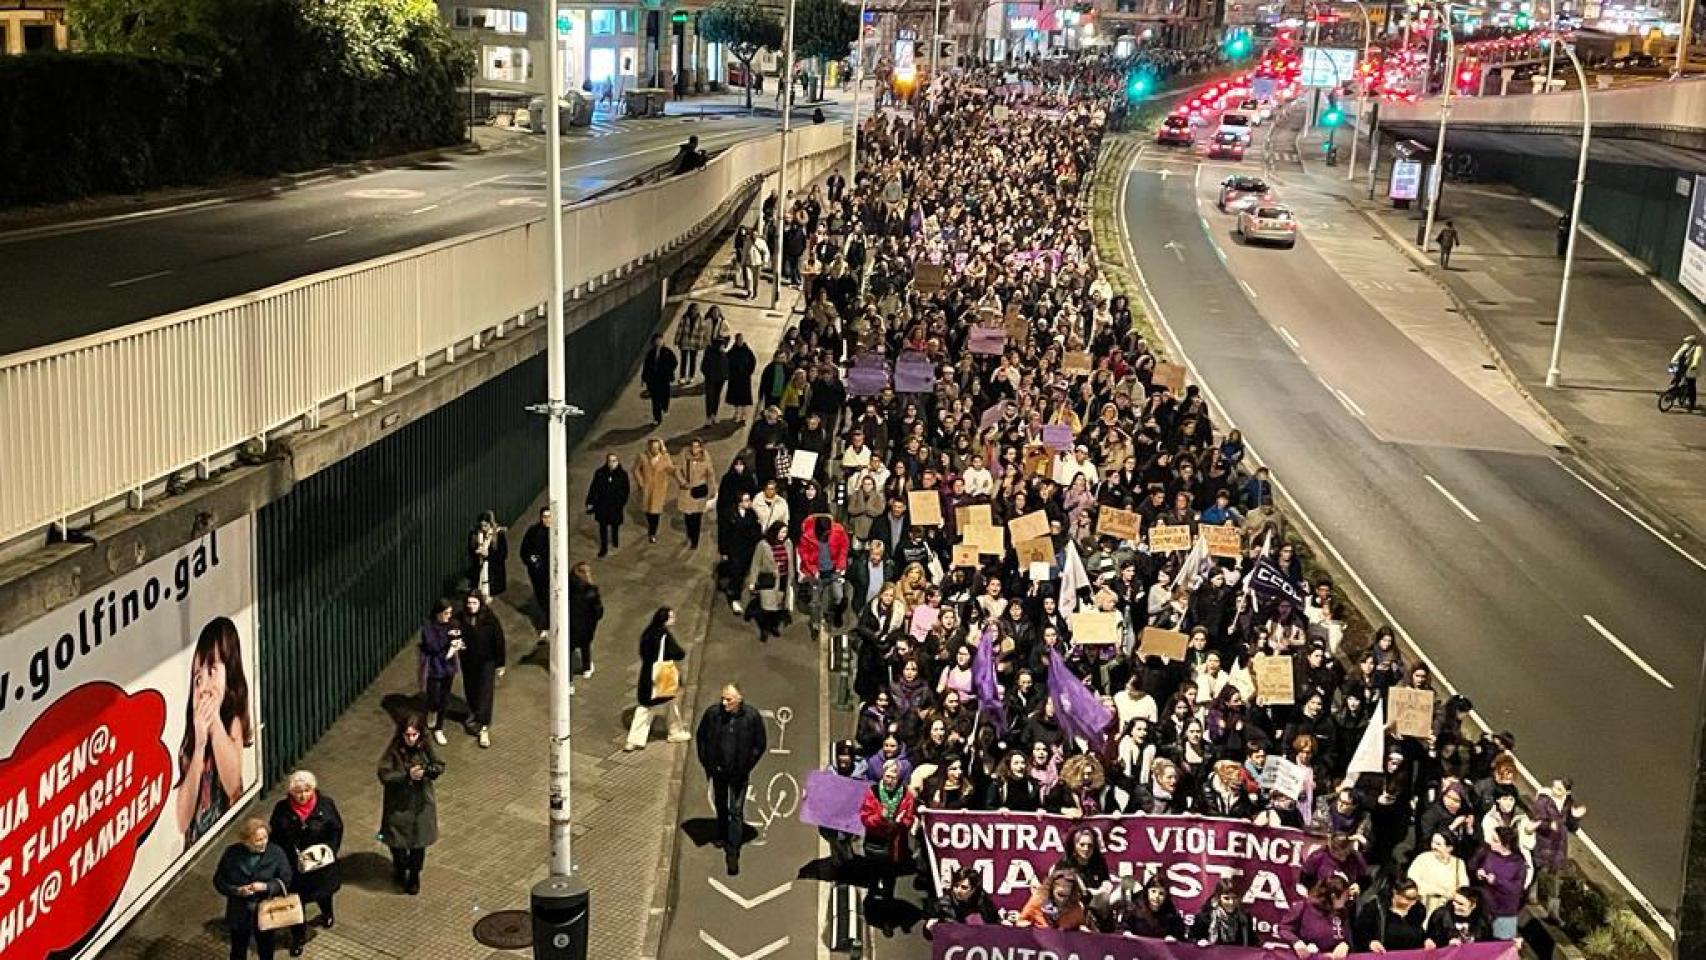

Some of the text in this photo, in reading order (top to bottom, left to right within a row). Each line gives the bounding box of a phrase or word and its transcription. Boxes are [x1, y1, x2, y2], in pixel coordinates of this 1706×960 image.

[22, 751, 134, 877] FLIPAR!!!
[69, 772, 164, 887] TAMBIÉN
[931, 822, 1065, 853] CONTRA
[1146, 826, 1321, 868] VIOLENCI
